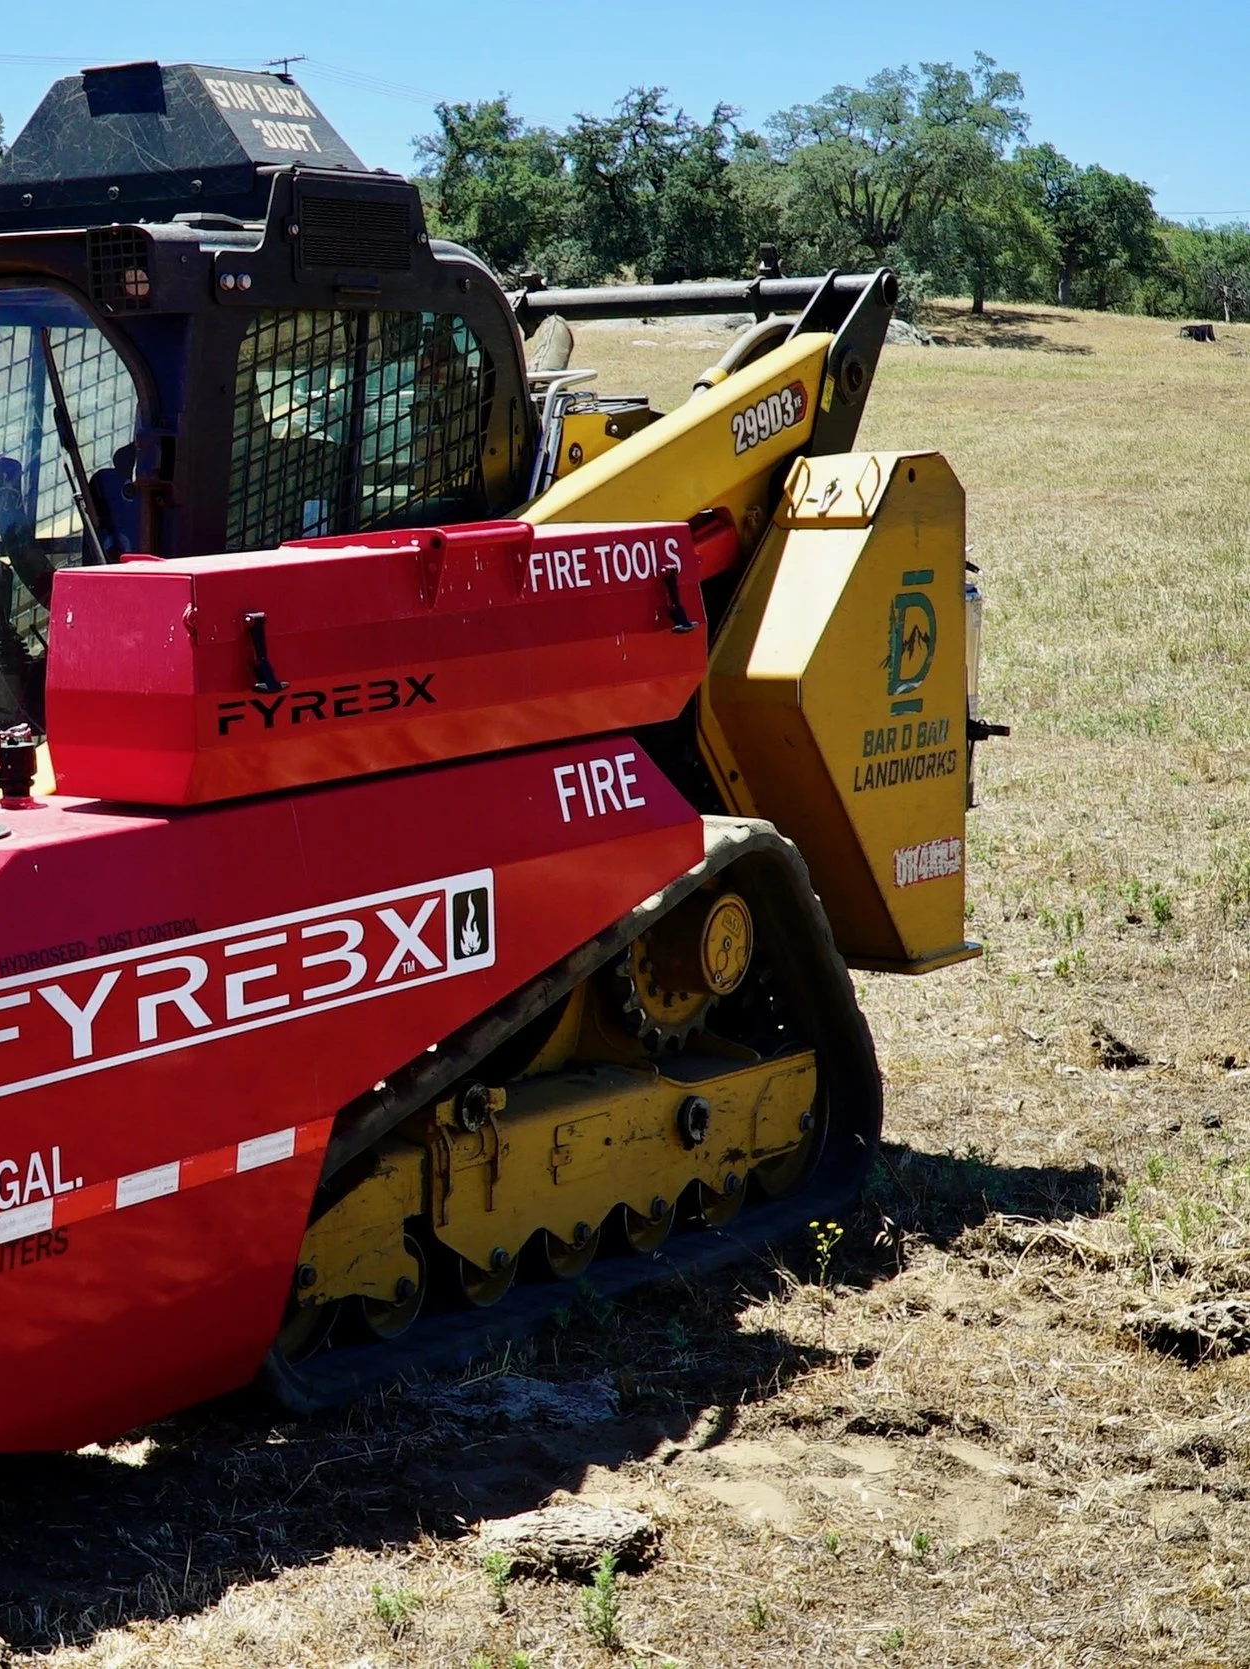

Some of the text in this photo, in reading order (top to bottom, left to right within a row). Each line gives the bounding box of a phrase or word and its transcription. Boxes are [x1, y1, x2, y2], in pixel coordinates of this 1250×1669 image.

[204, 78, 317, 119] STAY BACK
[251, 118, 322, 153] 300FT
[732, 388, 795, 456] 299D3
[529, 548, 591, 593] FIRE
[217, 673, 437, 736] FYREBX
[862, 727, 897, 758] BAR
[901, 724, 913, 751] D
[553, 752, 646, 823] FIRE
[853, 749, 957, 793] LANDWORKS
[97, 930, 135, 955] DUST
[136, 917, 203, 945] CONTROL
[401, 959, 416, 975] TM
